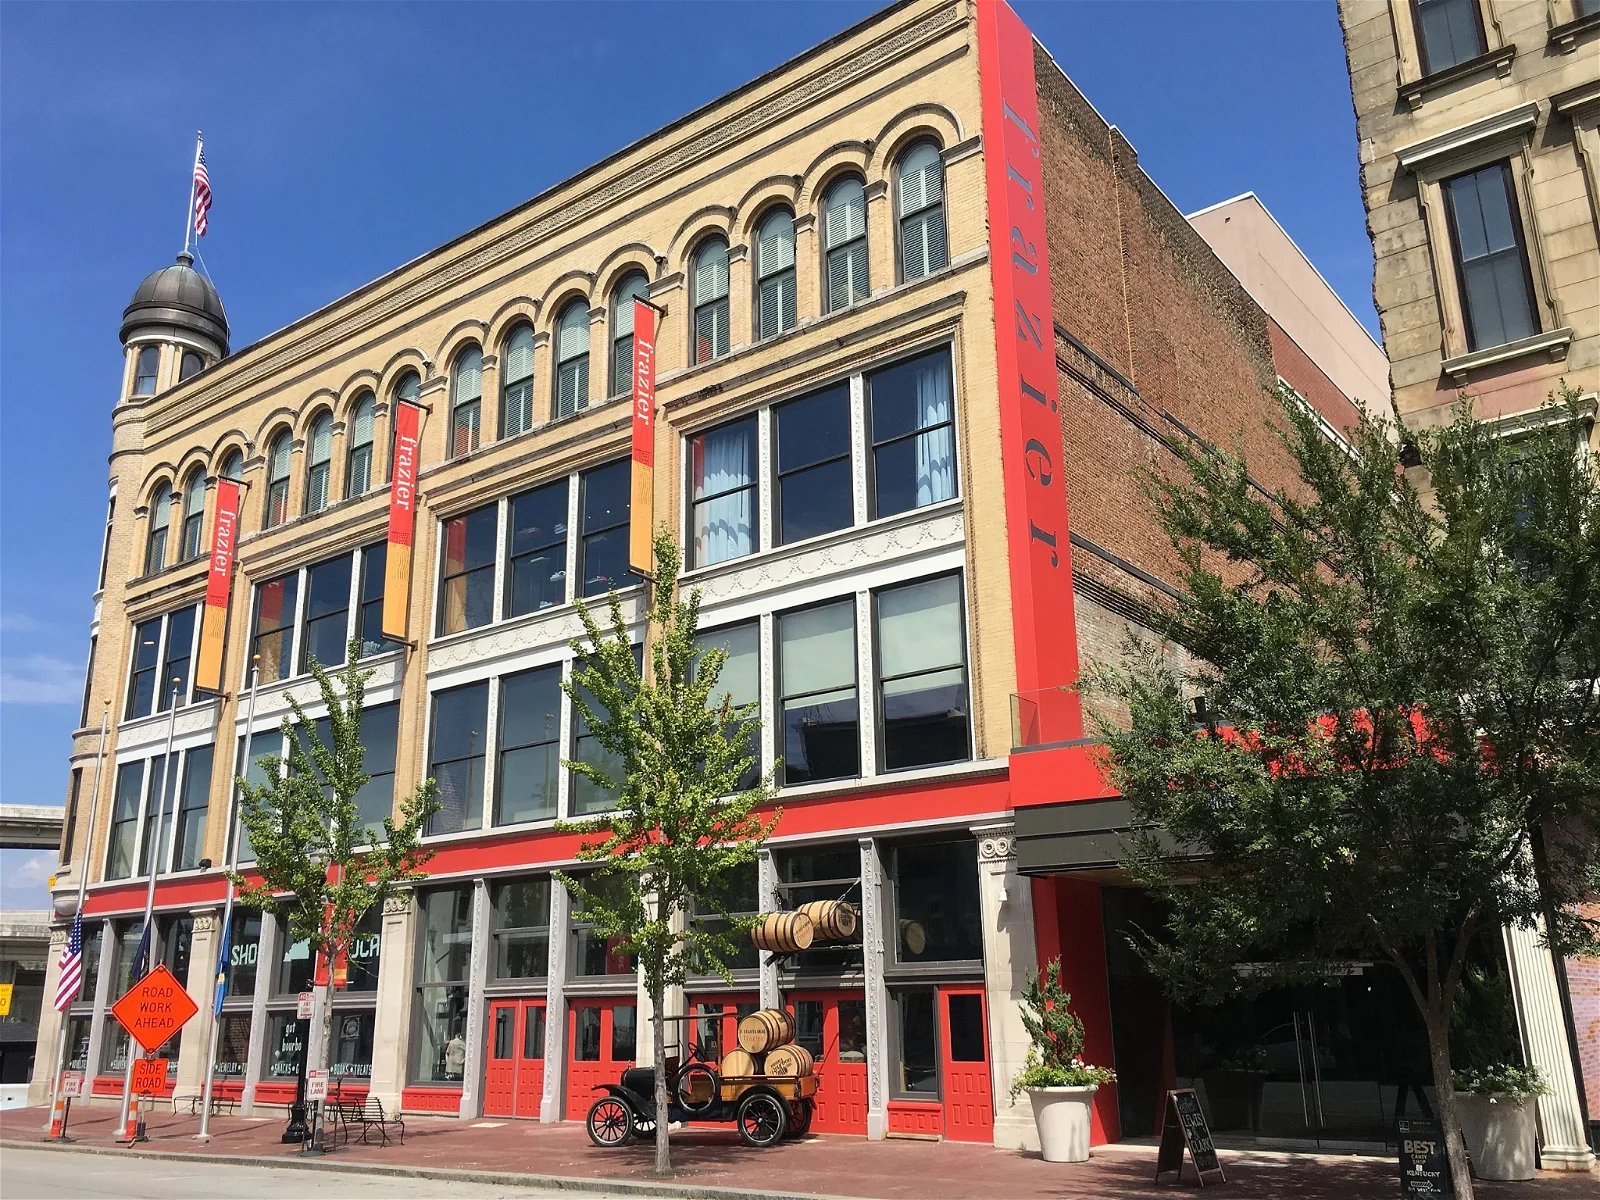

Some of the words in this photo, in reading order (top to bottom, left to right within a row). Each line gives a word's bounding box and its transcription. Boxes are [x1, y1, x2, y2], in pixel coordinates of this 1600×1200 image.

[1002, 96, 1060, 568] frazier
[637, 338, 654, 425] frazier
[397, 434, 418, 511] frazier
[214, 508, 236, 577] frazier
[231, 943, 258, 966] SHO
[350, 933, 380, 959] OCA
[142, 987, 173, 998] ROAD
[140, 1002, 172, 1013] WORK
[134, 1018, 174, 1028] AHEAD
[285, 1022, 296, 1037] got
[282, 1037, 302, 1052] bourbo
[140, 1063, 162, 1075] SIDE
[135, 1077, 162, 1088] ROAD
[1182, 1113, 1203, 1128] LEWIS
[1191, 1137, 1213, 1153] CLARK
[1403, 1140, 1436, 1155] BEST
[1406, 1170, 1441, 1178] KENTUCKY
